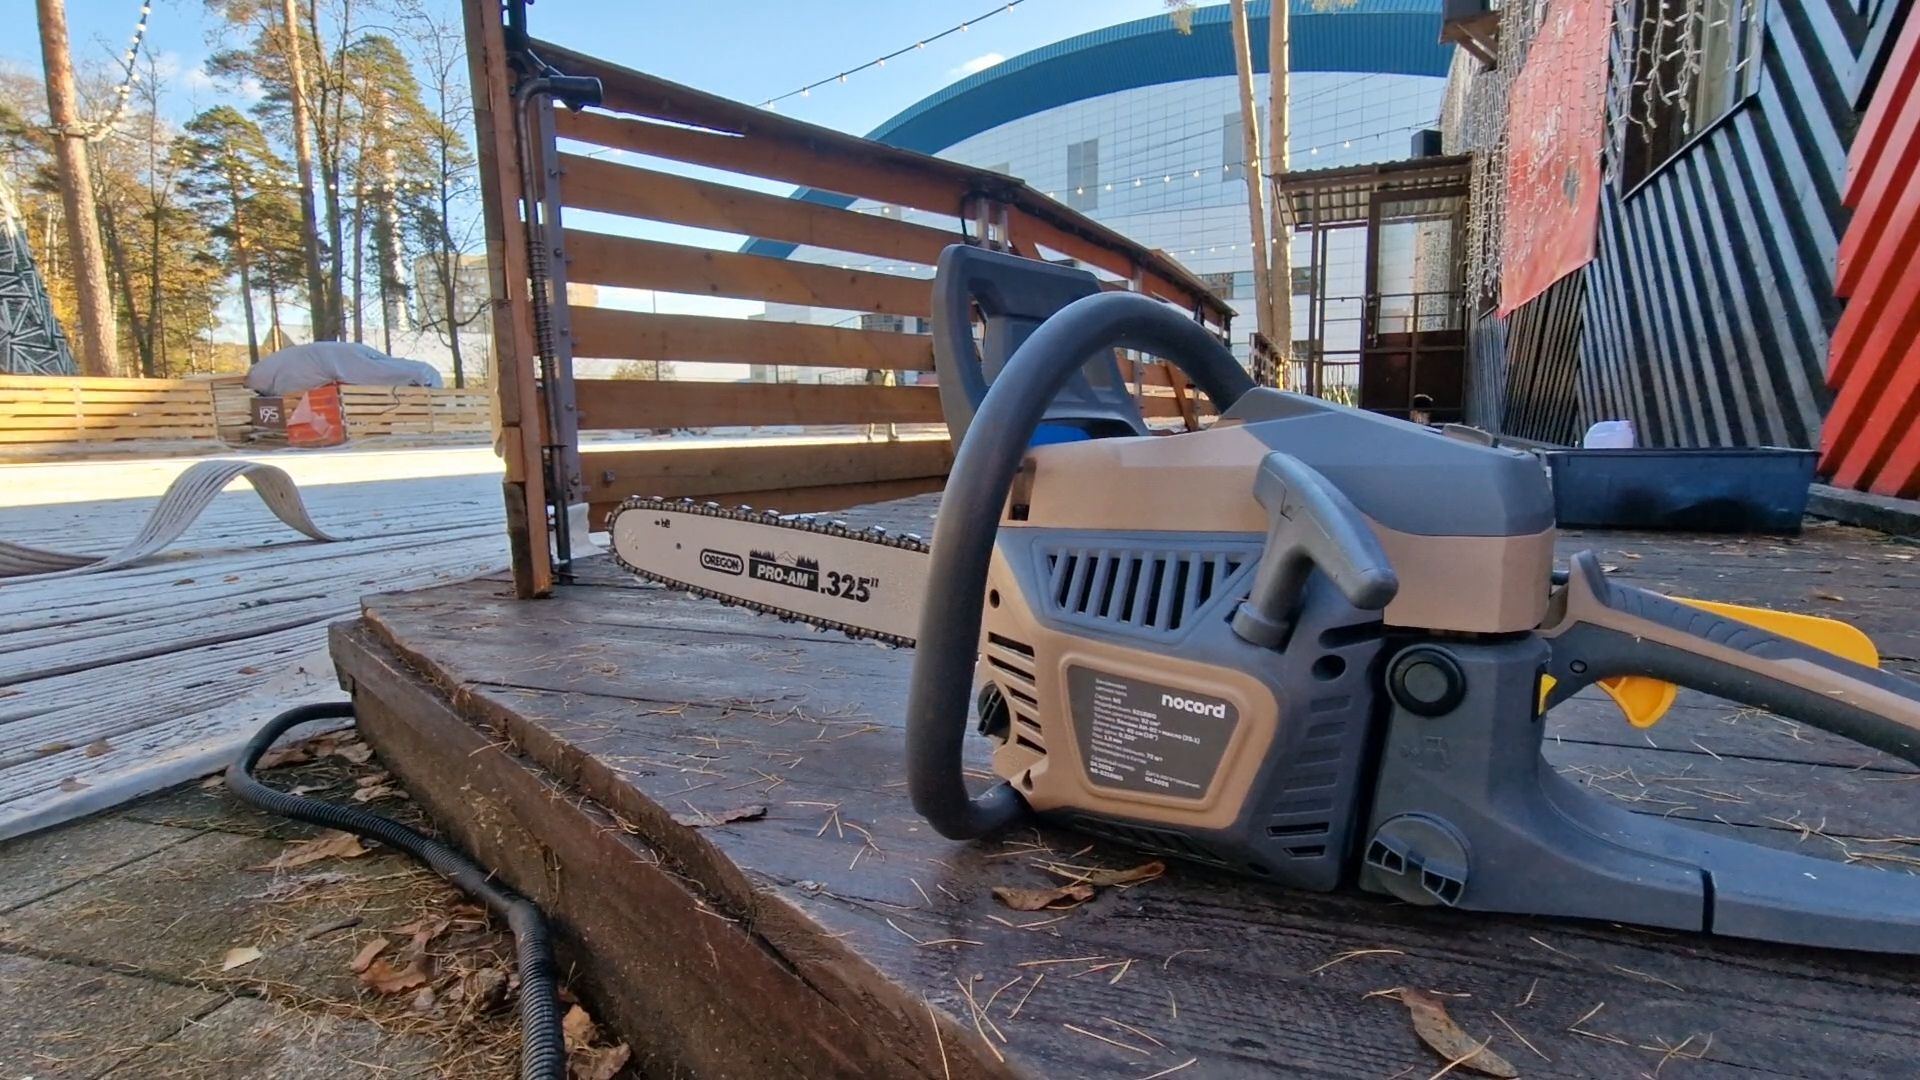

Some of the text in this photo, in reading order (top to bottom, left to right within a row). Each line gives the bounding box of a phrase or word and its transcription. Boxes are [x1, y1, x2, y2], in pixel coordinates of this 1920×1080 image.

[703, 553, 740, 571] OREGON
[756, 563, 880, 603] PRO-AM .325"
[1161, 694, 1226, 719] nocord
